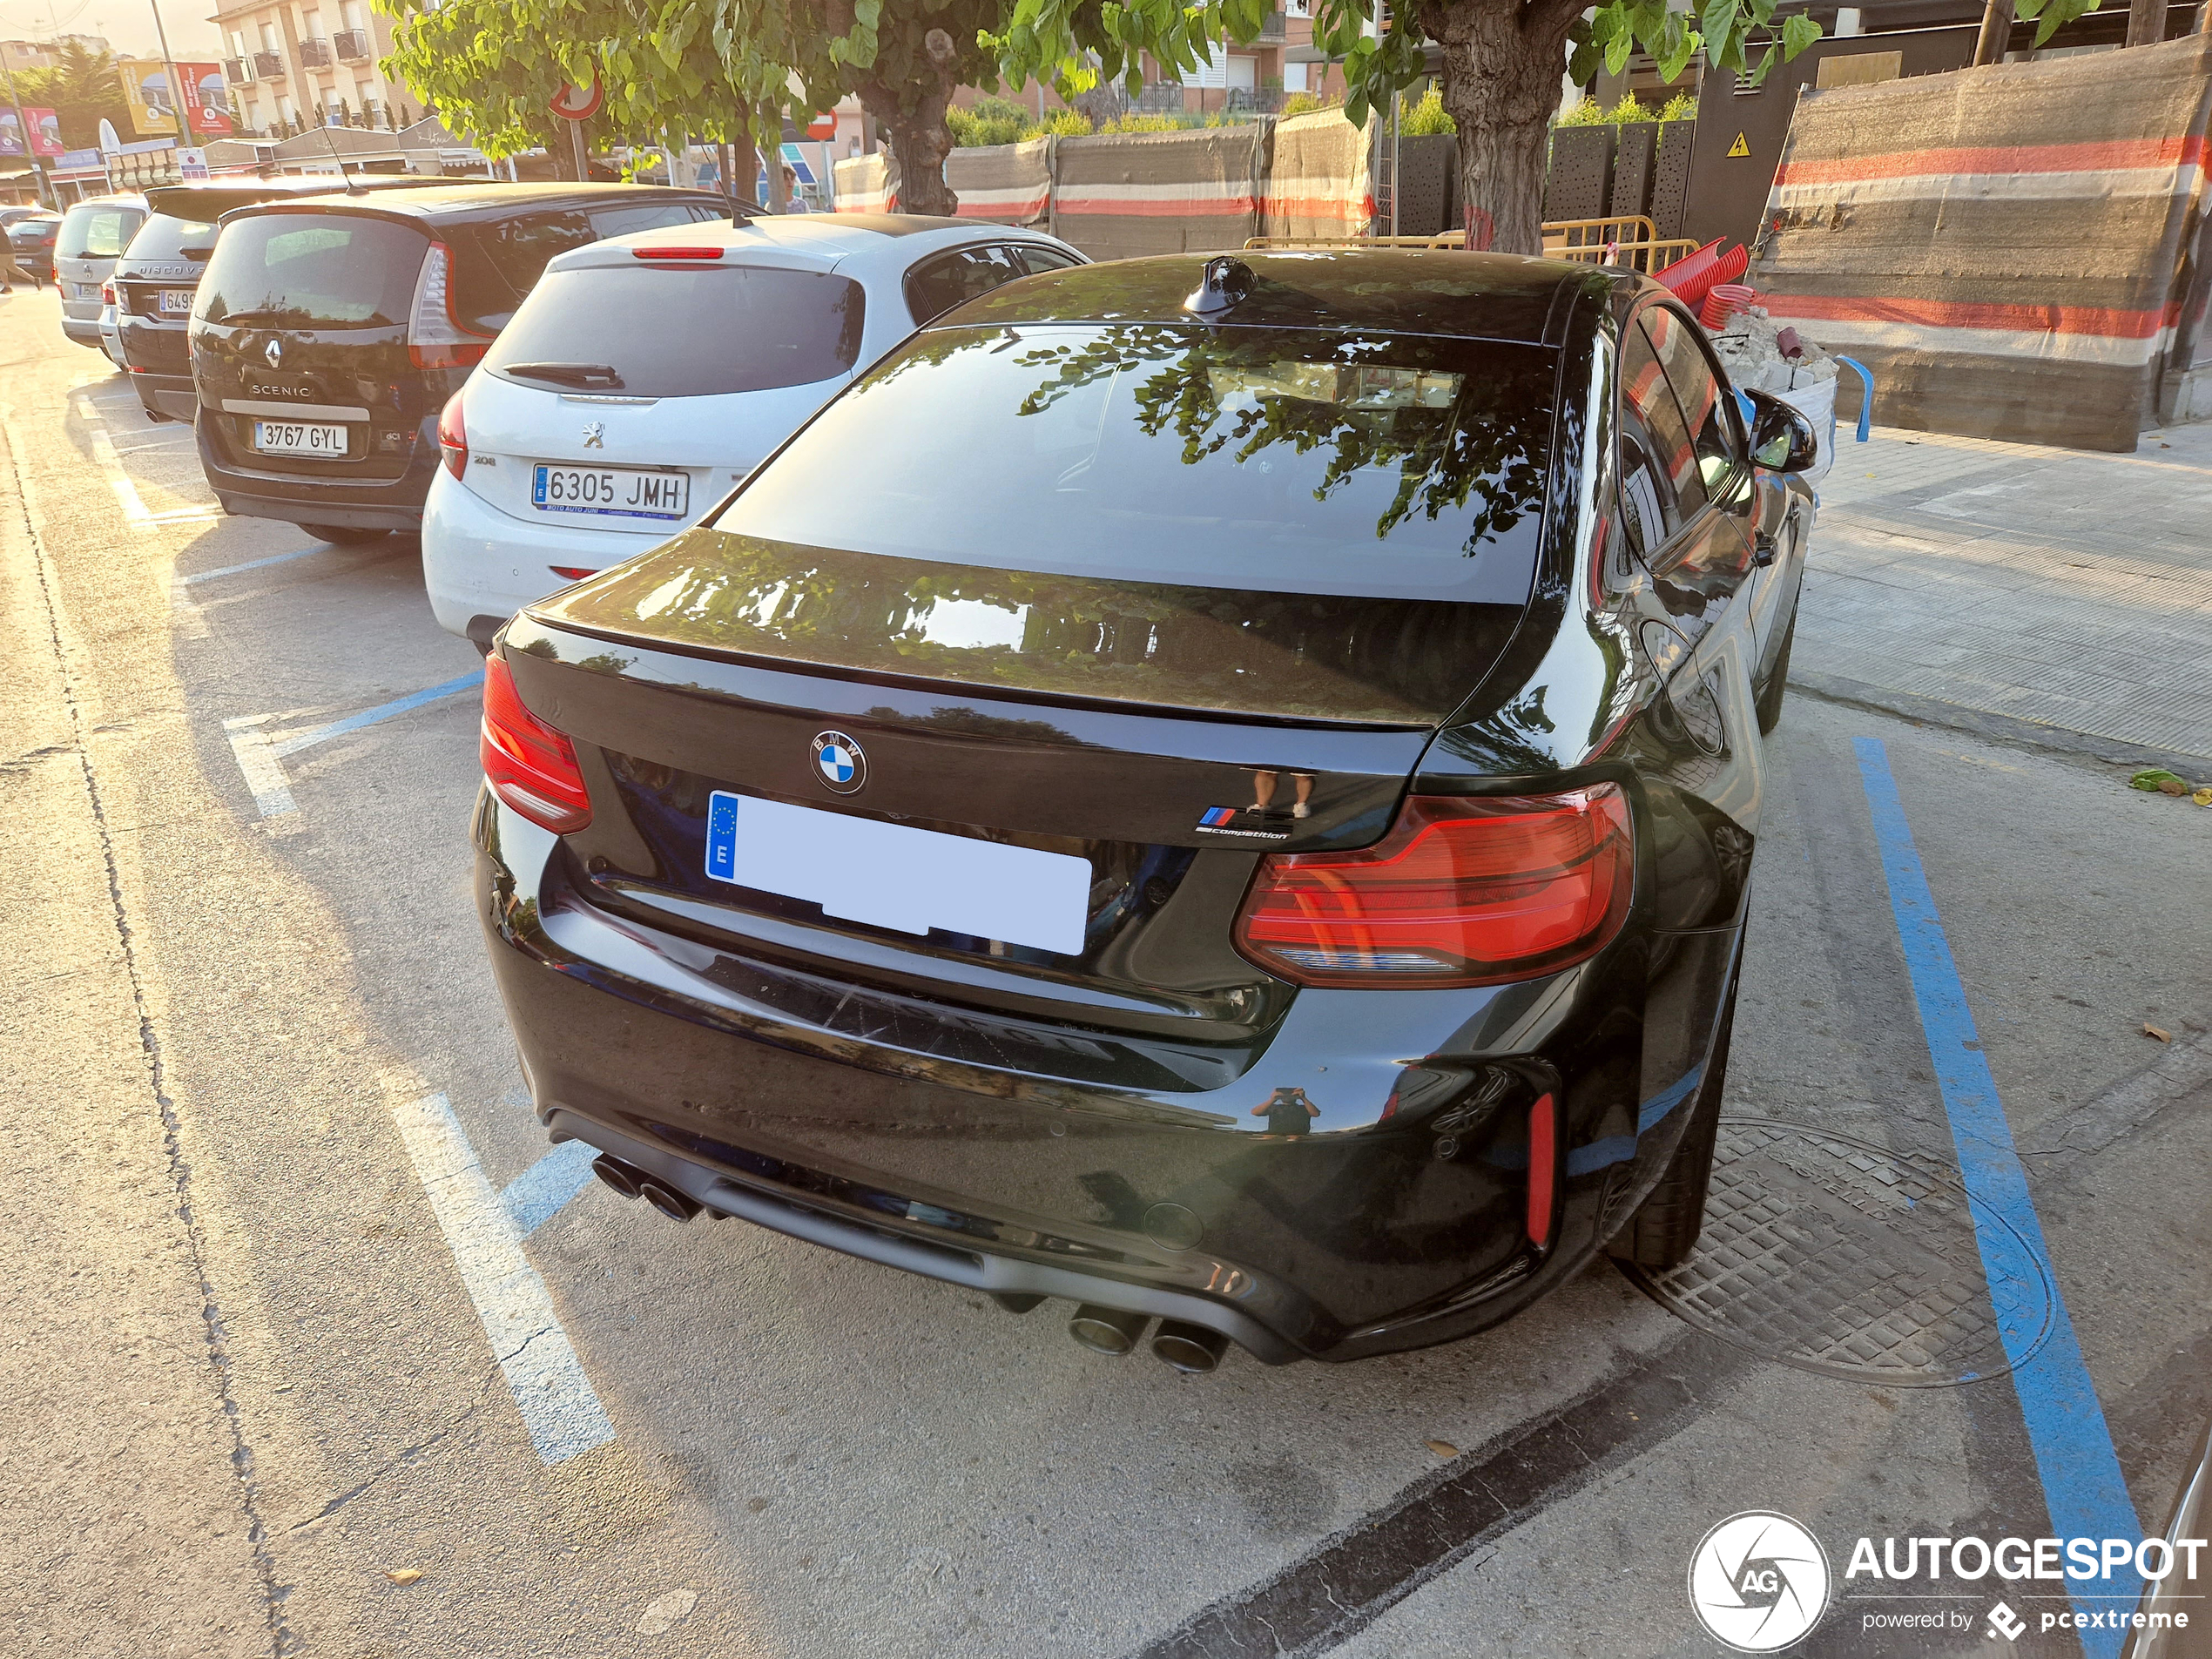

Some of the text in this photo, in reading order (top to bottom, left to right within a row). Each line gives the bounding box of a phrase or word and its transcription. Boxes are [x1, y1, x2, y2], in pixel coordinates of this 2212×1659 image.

[184, 79, 195, 108] Me gusta
[187, 67, 201, 108] nuestra Playa
[252, 384, 311, 398] SCENIC
[266, 425, 342, 450] 3767 GYL
[474, 455, 496, 466] 208
[538, 488, 543, 497] E
[550, 471, 679, 509] 6305 JMH
[813, 733, 860, 757] BMW
[1211, 829, 1288, 840] competition
[717, 845, 728, 864] E
